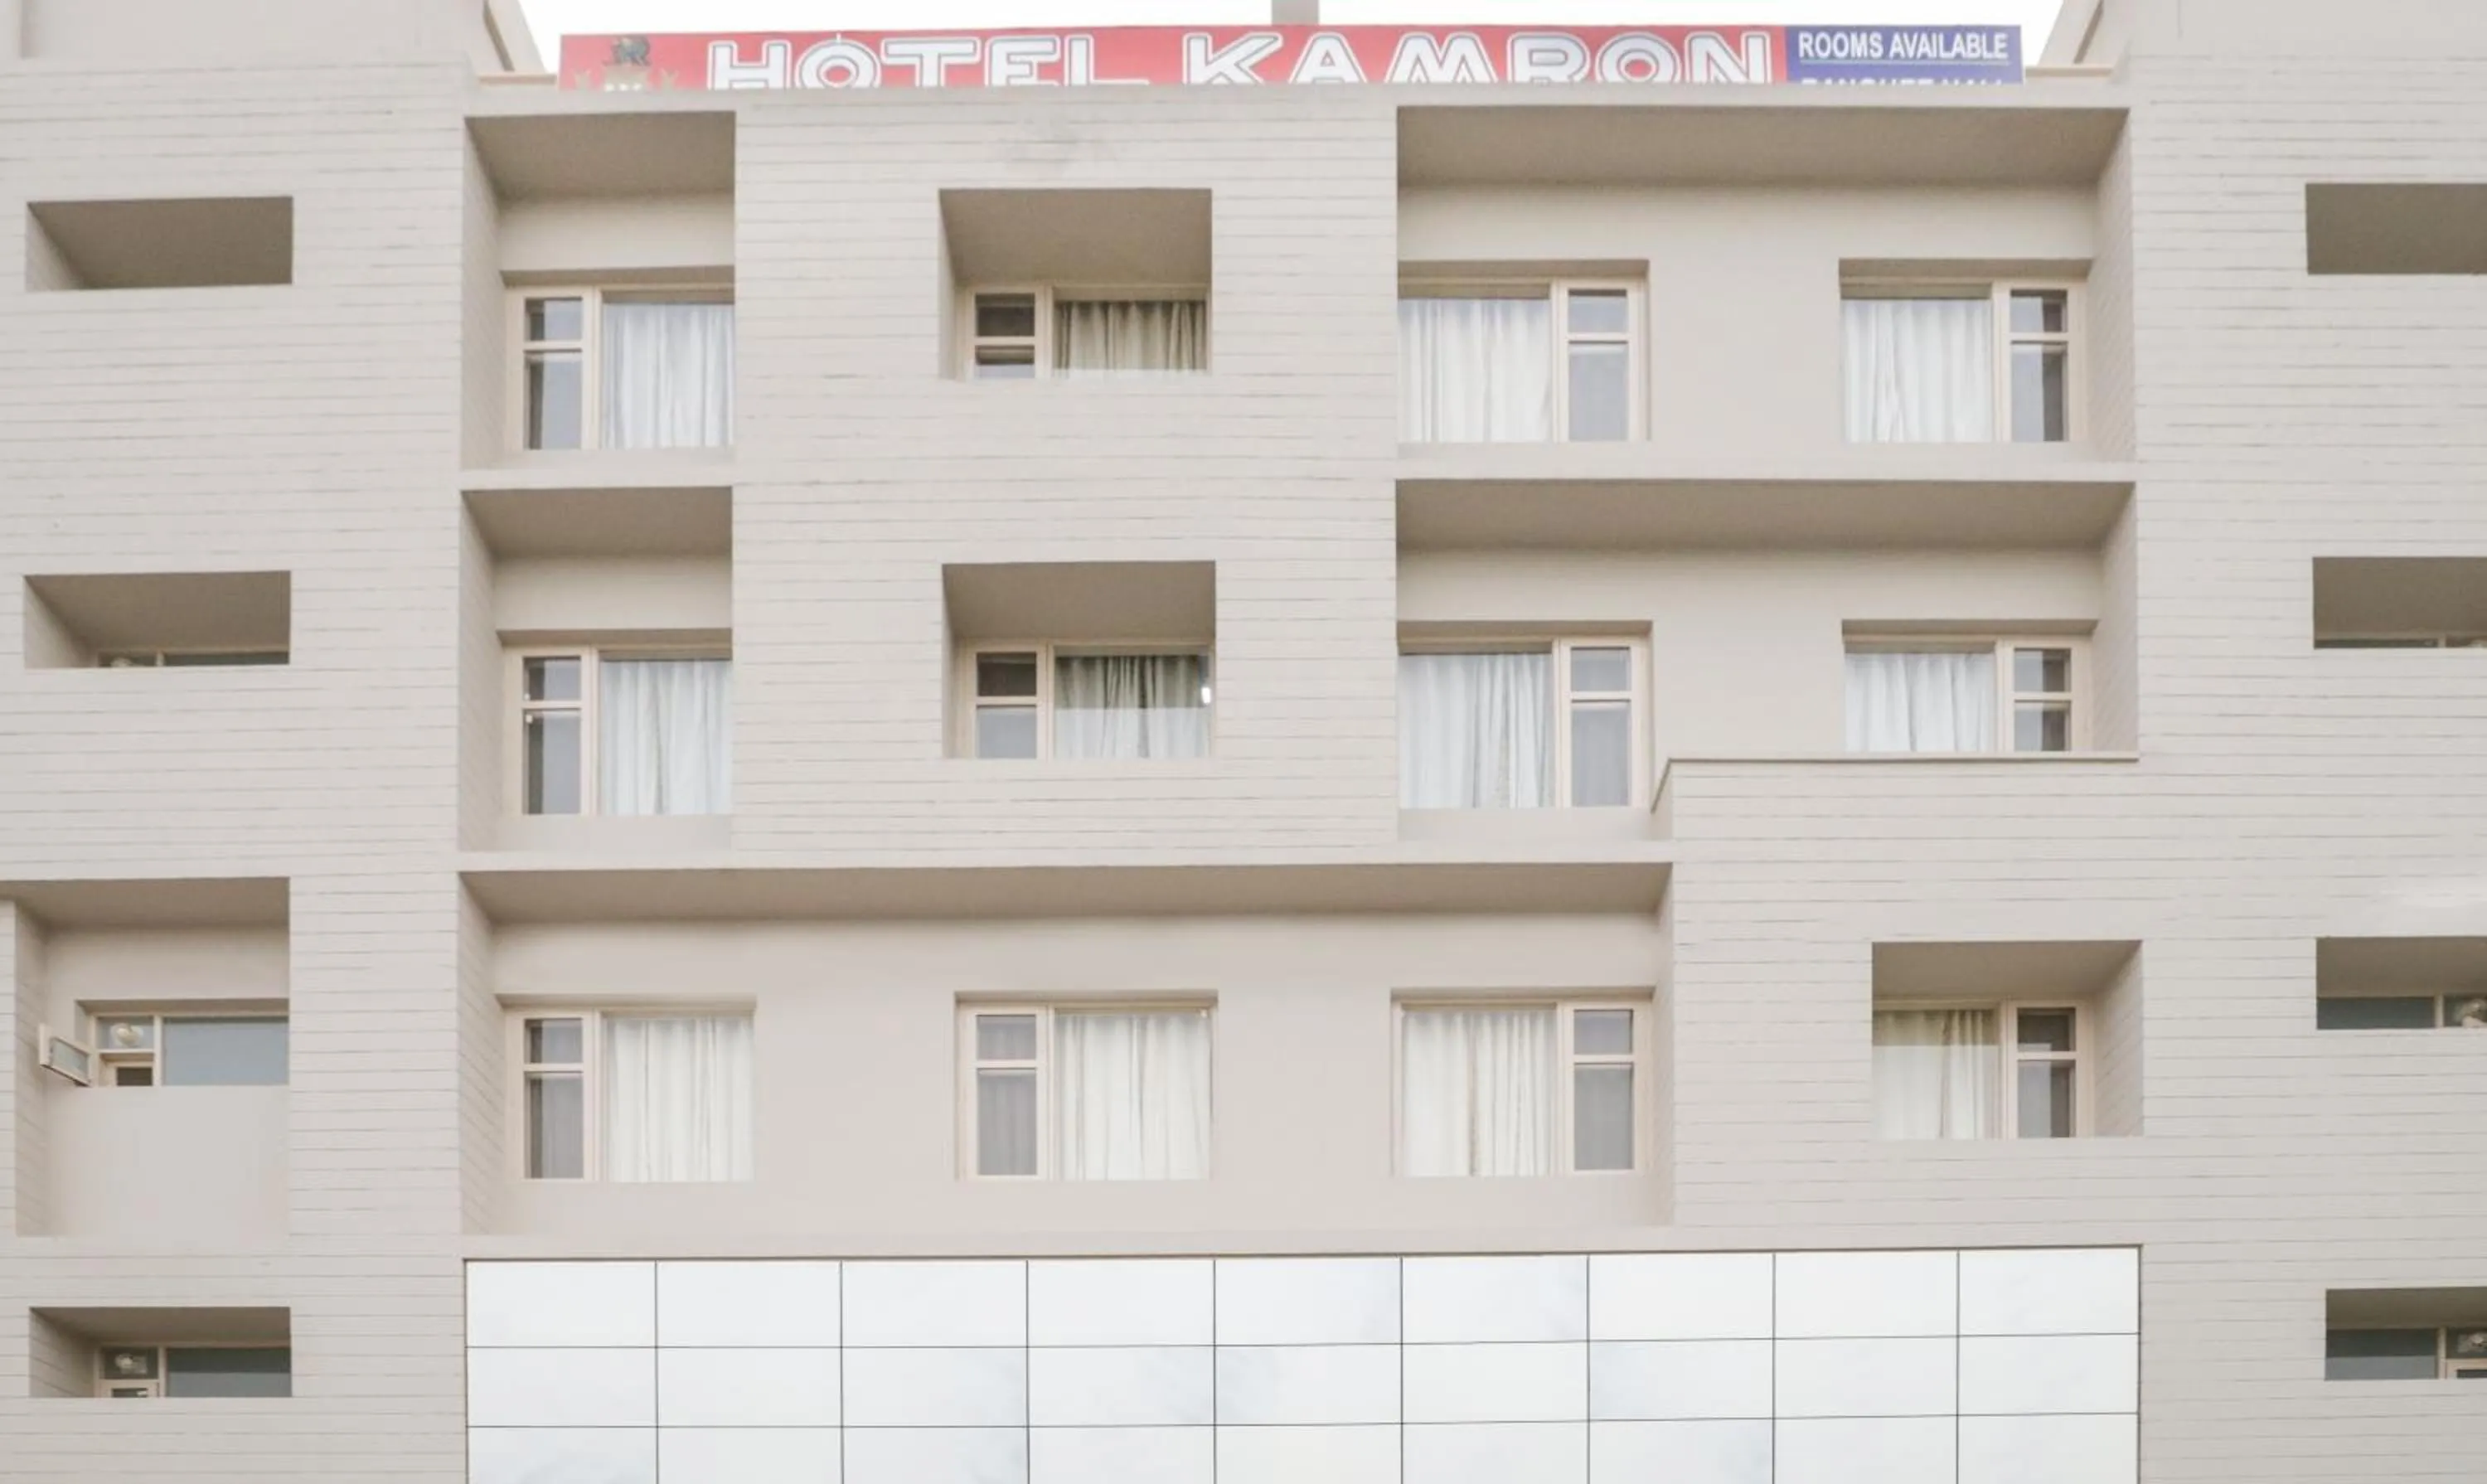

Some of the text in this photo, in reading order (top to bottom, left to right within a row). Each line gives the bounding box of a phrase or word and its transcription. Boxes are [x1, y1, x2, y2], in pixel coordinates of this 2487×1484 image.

[705, 31, 1772, 90] HOTEL KAMRON
[1799, 32, 2008, 59] ROOMS AVAILABLE
